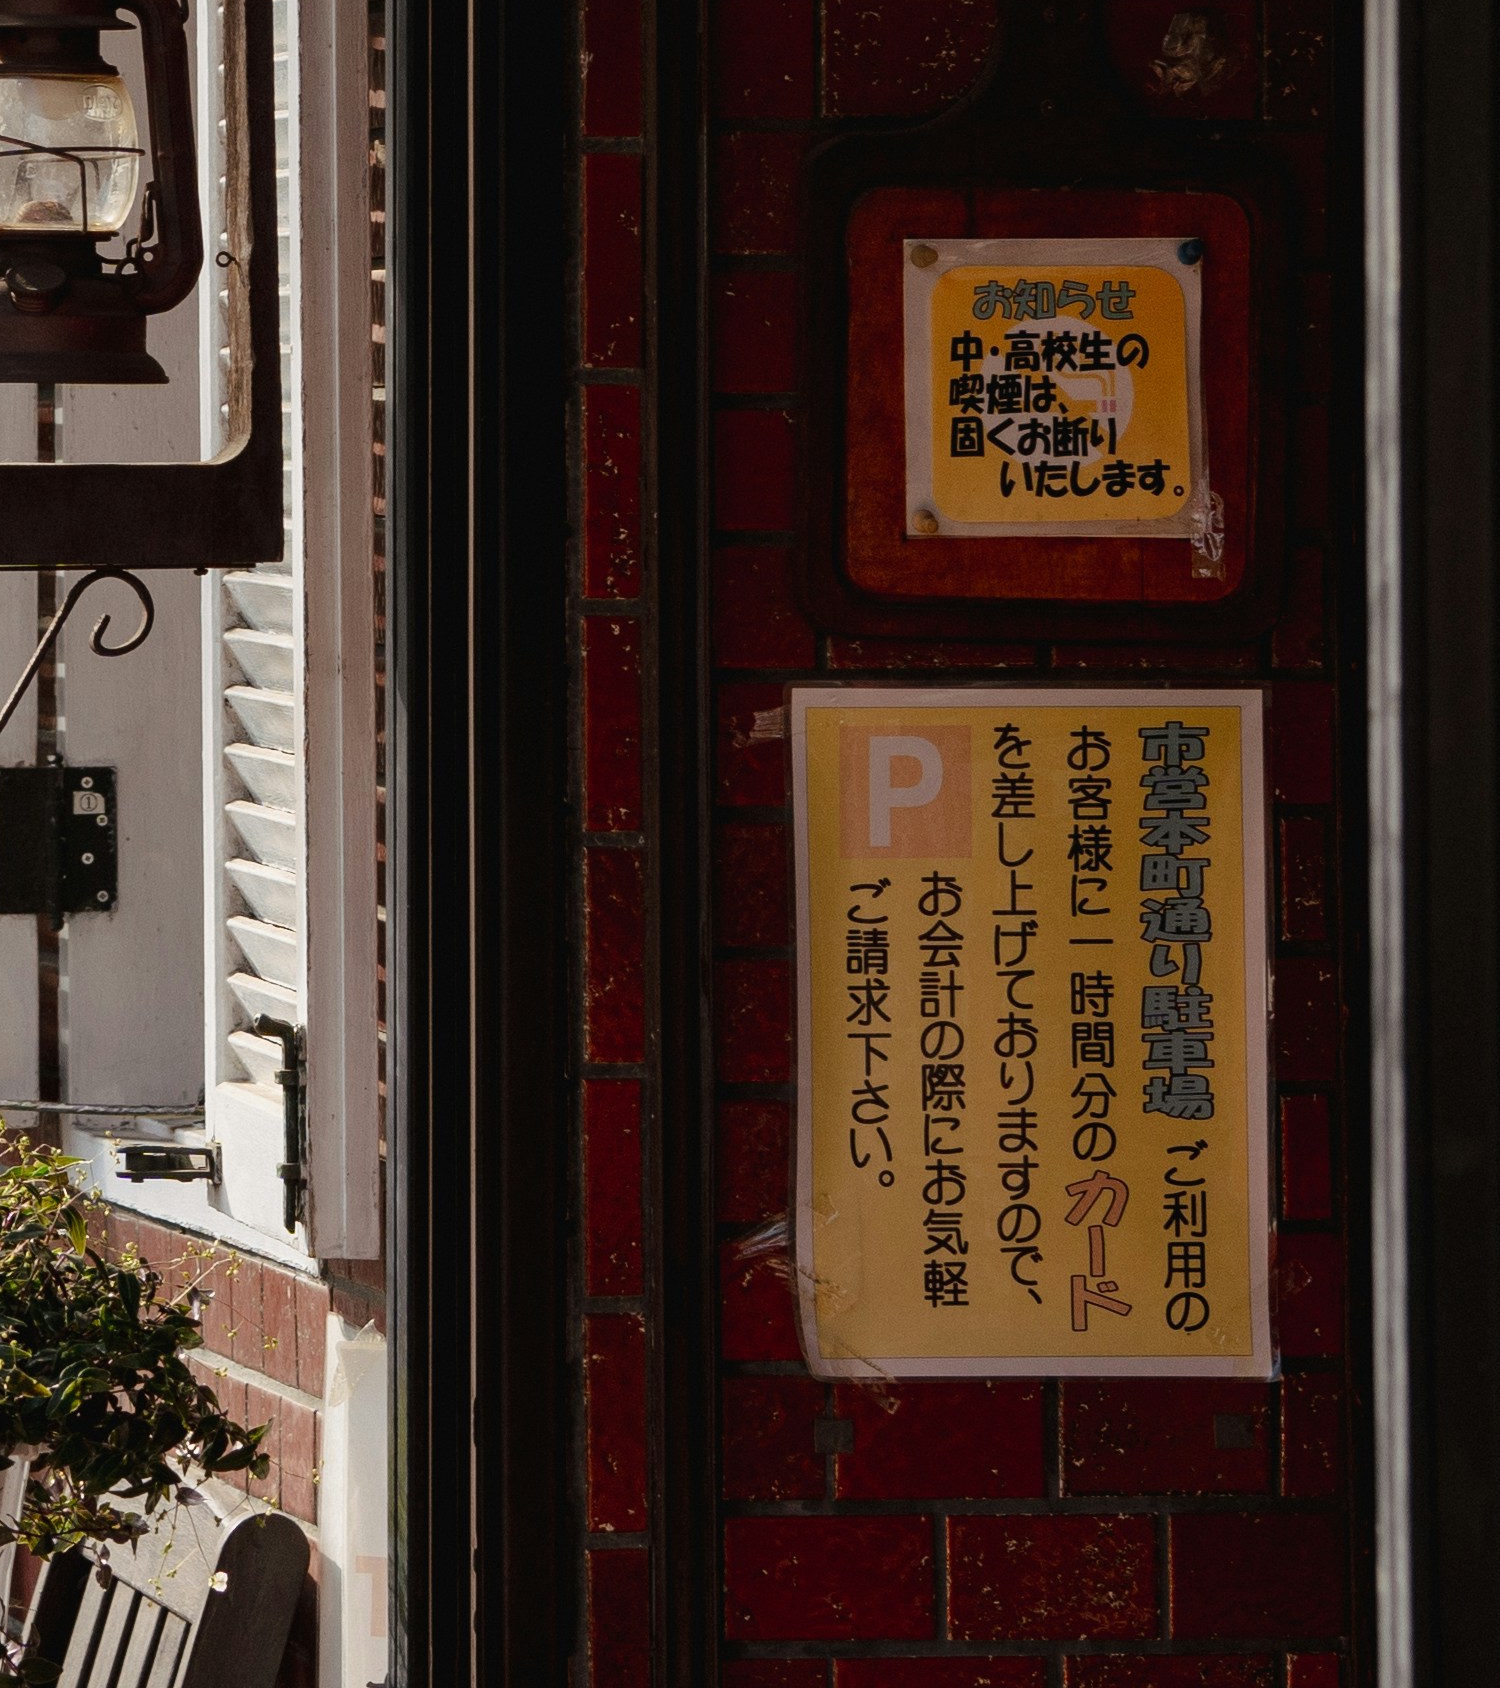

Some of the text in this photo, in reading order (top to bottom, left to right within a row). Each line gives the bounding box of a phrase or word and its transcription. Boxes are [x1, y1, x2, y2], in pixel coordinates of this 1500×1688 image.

[972, 279, 1136, 321] お知らせ
[949, 330, 1150, 373] 中・高校生の
[948, 373, 1069, 415] 喫煙は、
[949, 416, 1117, 458] 固くお断り
[1000, 459, 1185, 498] いたします。
[868, 735, 944, 848] P
[845, 876, 895, 1189] ご請求下さい。
[990, 722, 1043, 1307] を差し上げておりますので、
[1139, 720, 1215, 1334] 市営本町通り駐車場 ご利用の
[917, 870, 970, 1309] お会計の際にお気軽
